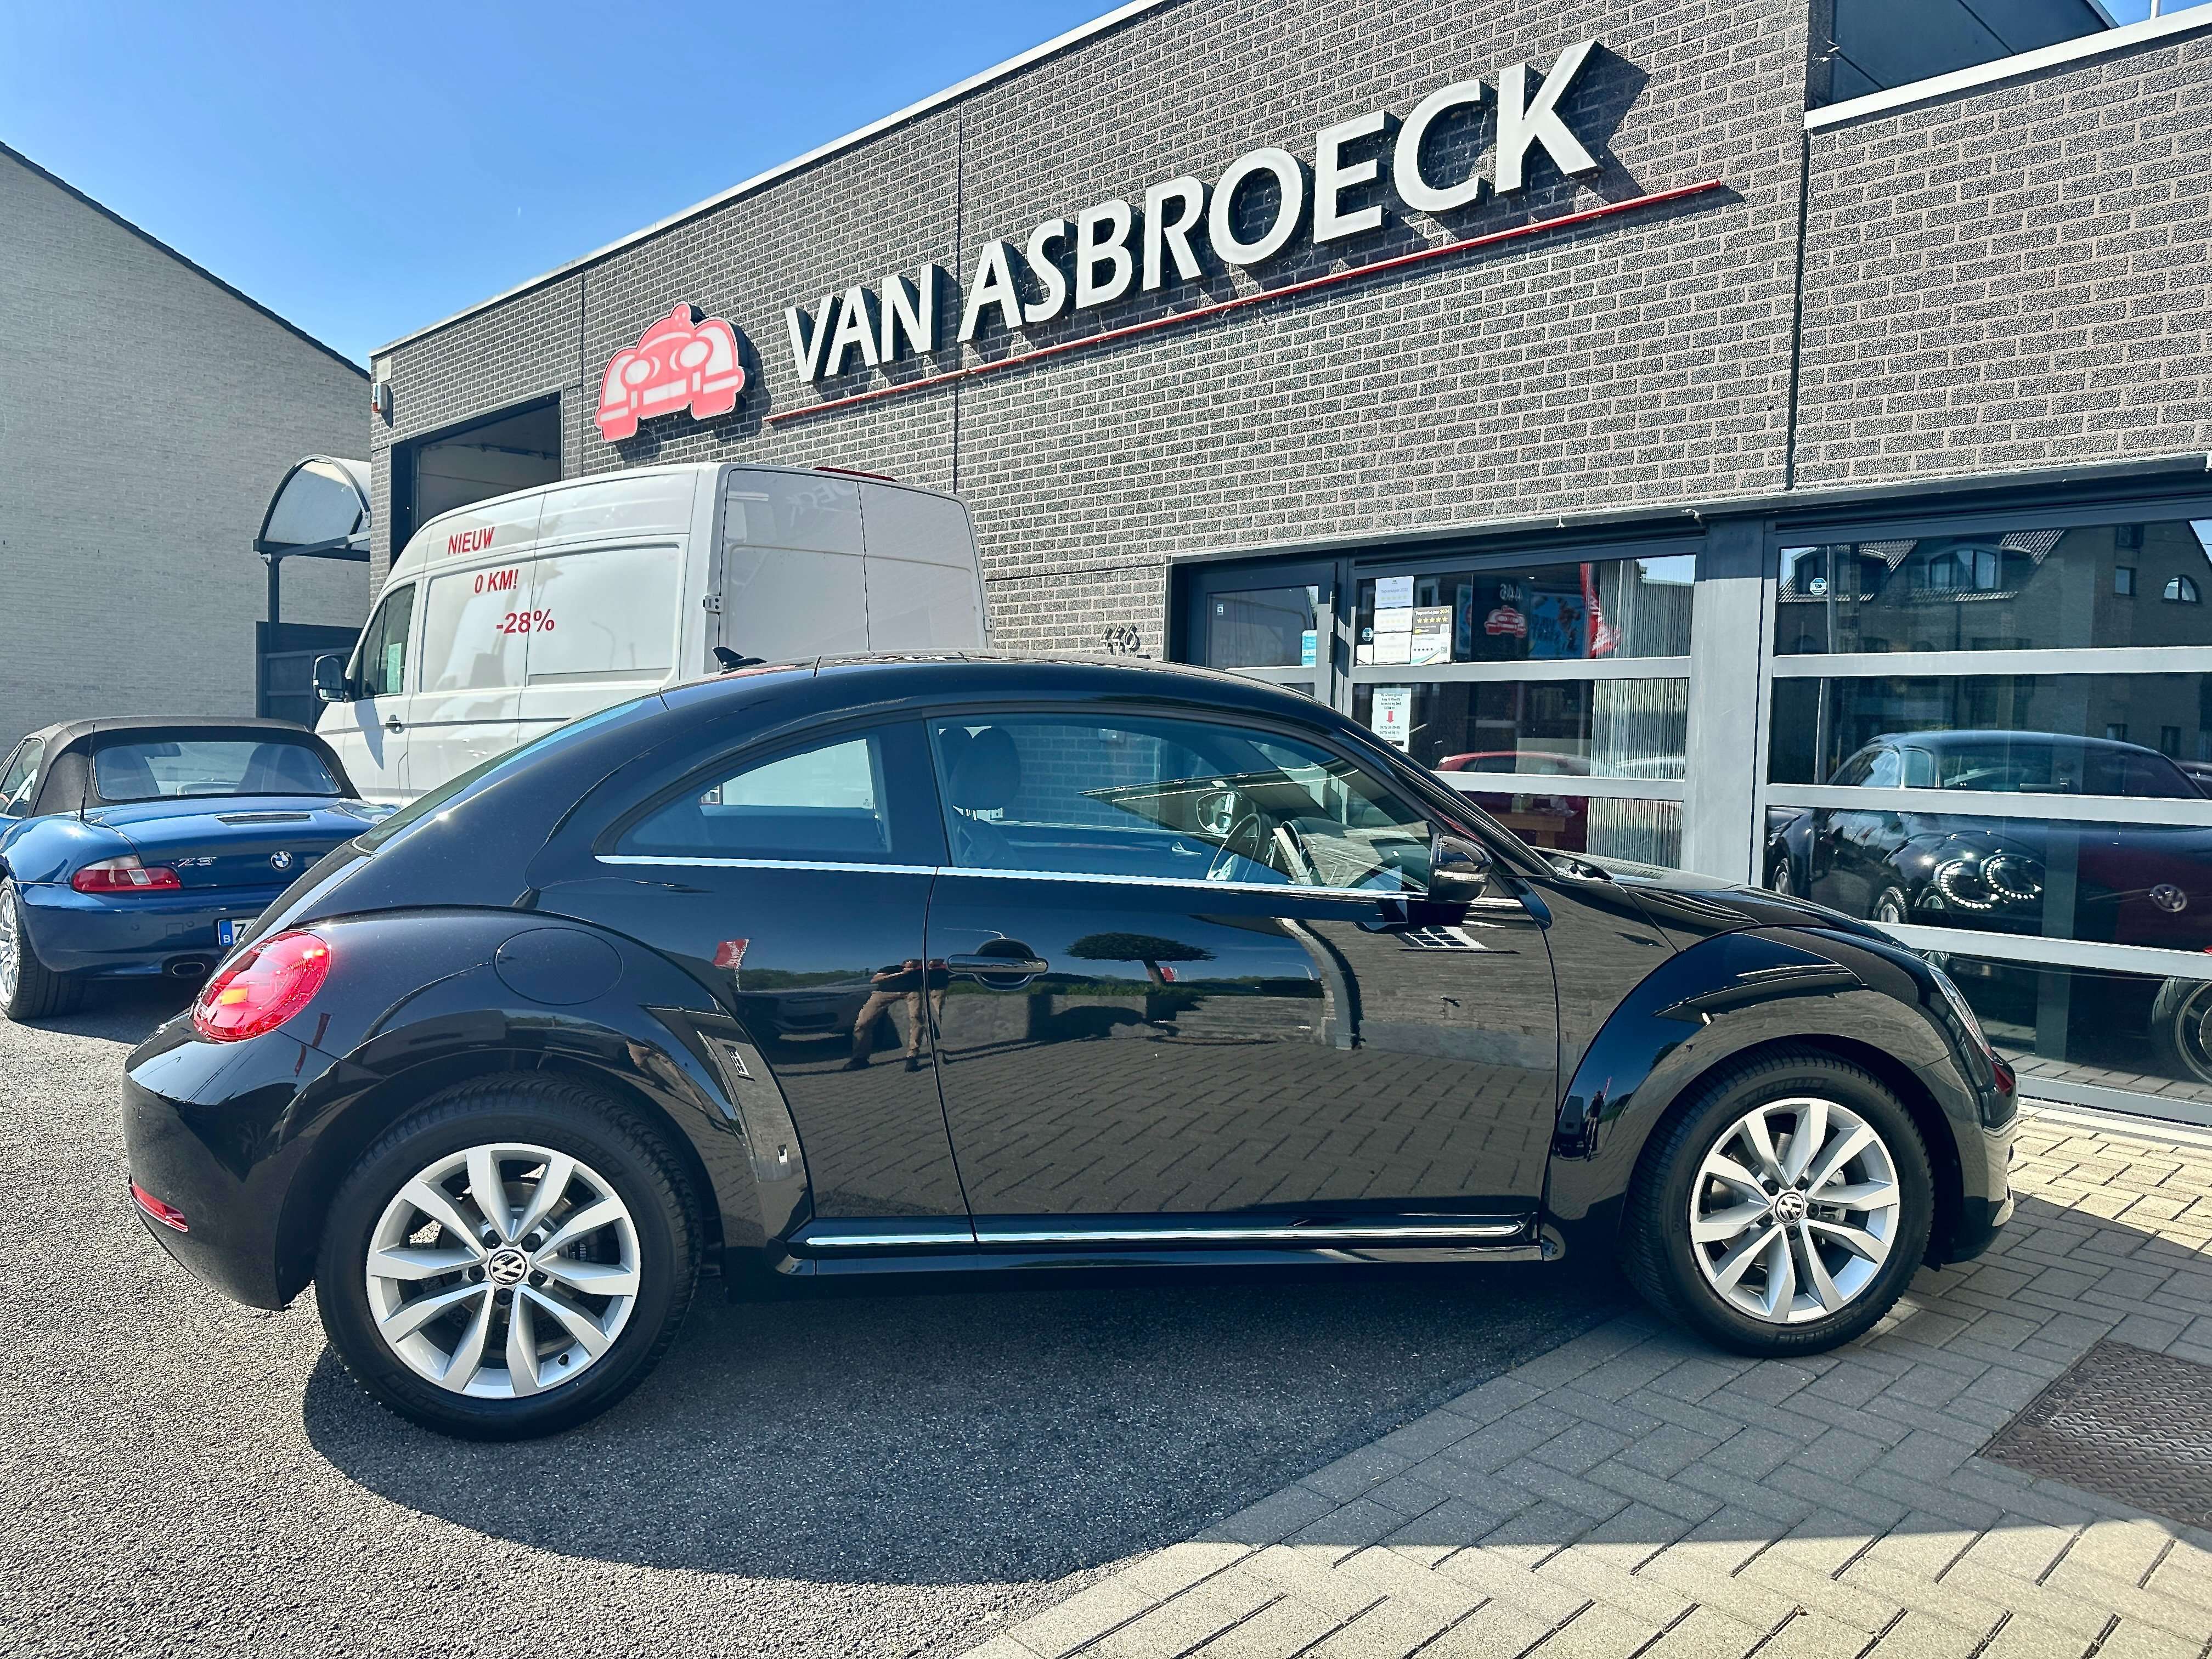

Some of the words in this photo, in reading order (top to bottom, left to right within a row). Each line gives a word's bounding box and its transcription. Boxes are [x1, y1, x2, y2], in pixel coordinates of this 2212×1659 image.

[784, 263, 933, 383] VAN
[956, 38, 1598, 343] ASBROECK
[447, 526, 495, 555] NIEUW
[474, 574, 484, 594] 0
[487, 569, 519, 592] KM!
[496, 608, 555, 634] -28%
[177, 856, 218, 868] Z3
[223, 934, 231, 944] B
